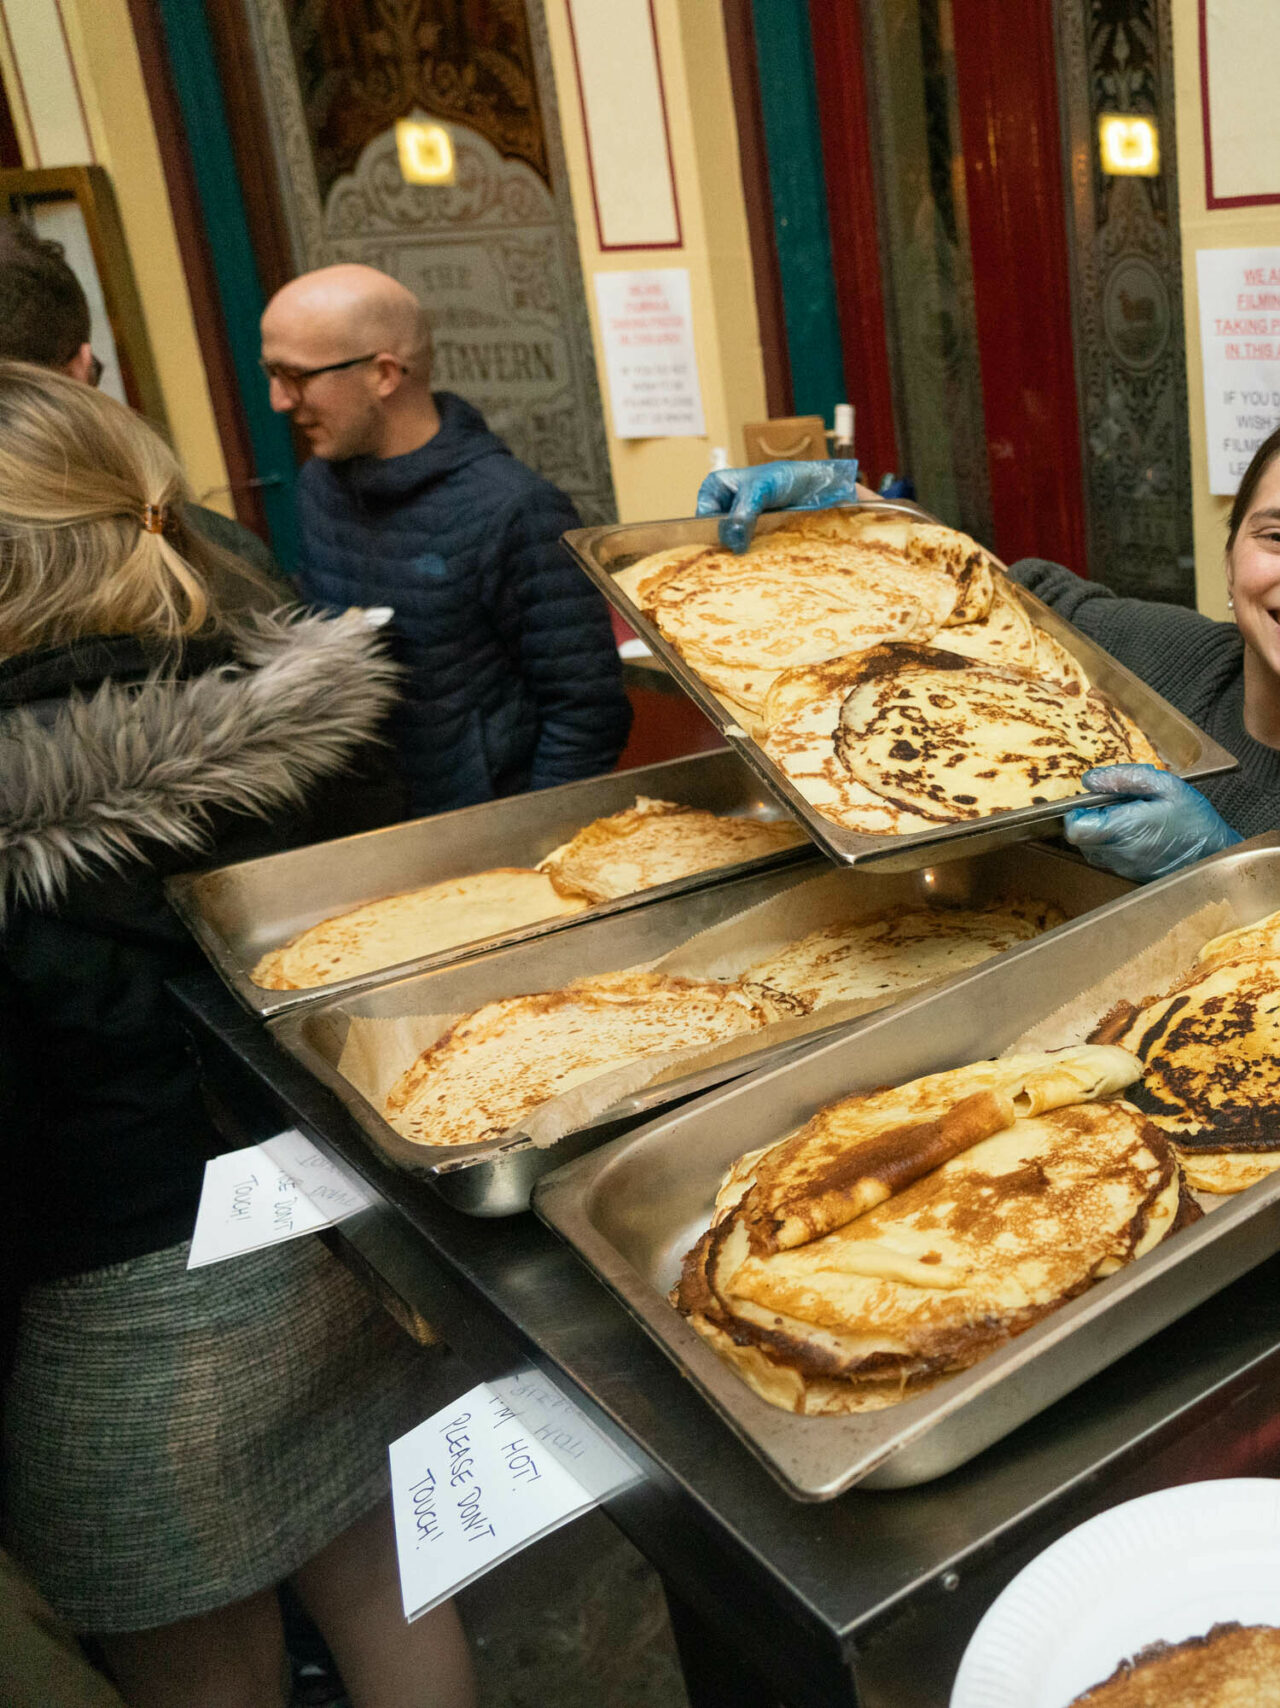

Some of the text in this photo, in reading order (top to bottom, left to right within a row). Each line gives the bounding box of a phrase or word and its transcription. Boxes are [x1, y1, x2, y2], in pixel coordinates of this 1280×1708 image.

[1243, 268, 1265, 285] WE
[1214, 318, 1268, 336] TAKING
[1225, 342, 1240, 360] IN
[1244, 342, 1273, 360] THIS
[436, 340, 556, 383] TAVERN
[1222, 390, 1236, 405] IF
[1240, 390, 1271, 407] YOU
[1235, 414, 1271, 430] WISH
[500, 1438, 542, 1492] HOT!
[439, 1412, 496, 1542] PLEASE DON'T
[408, 1468, 444, 1550] TOUCH!
